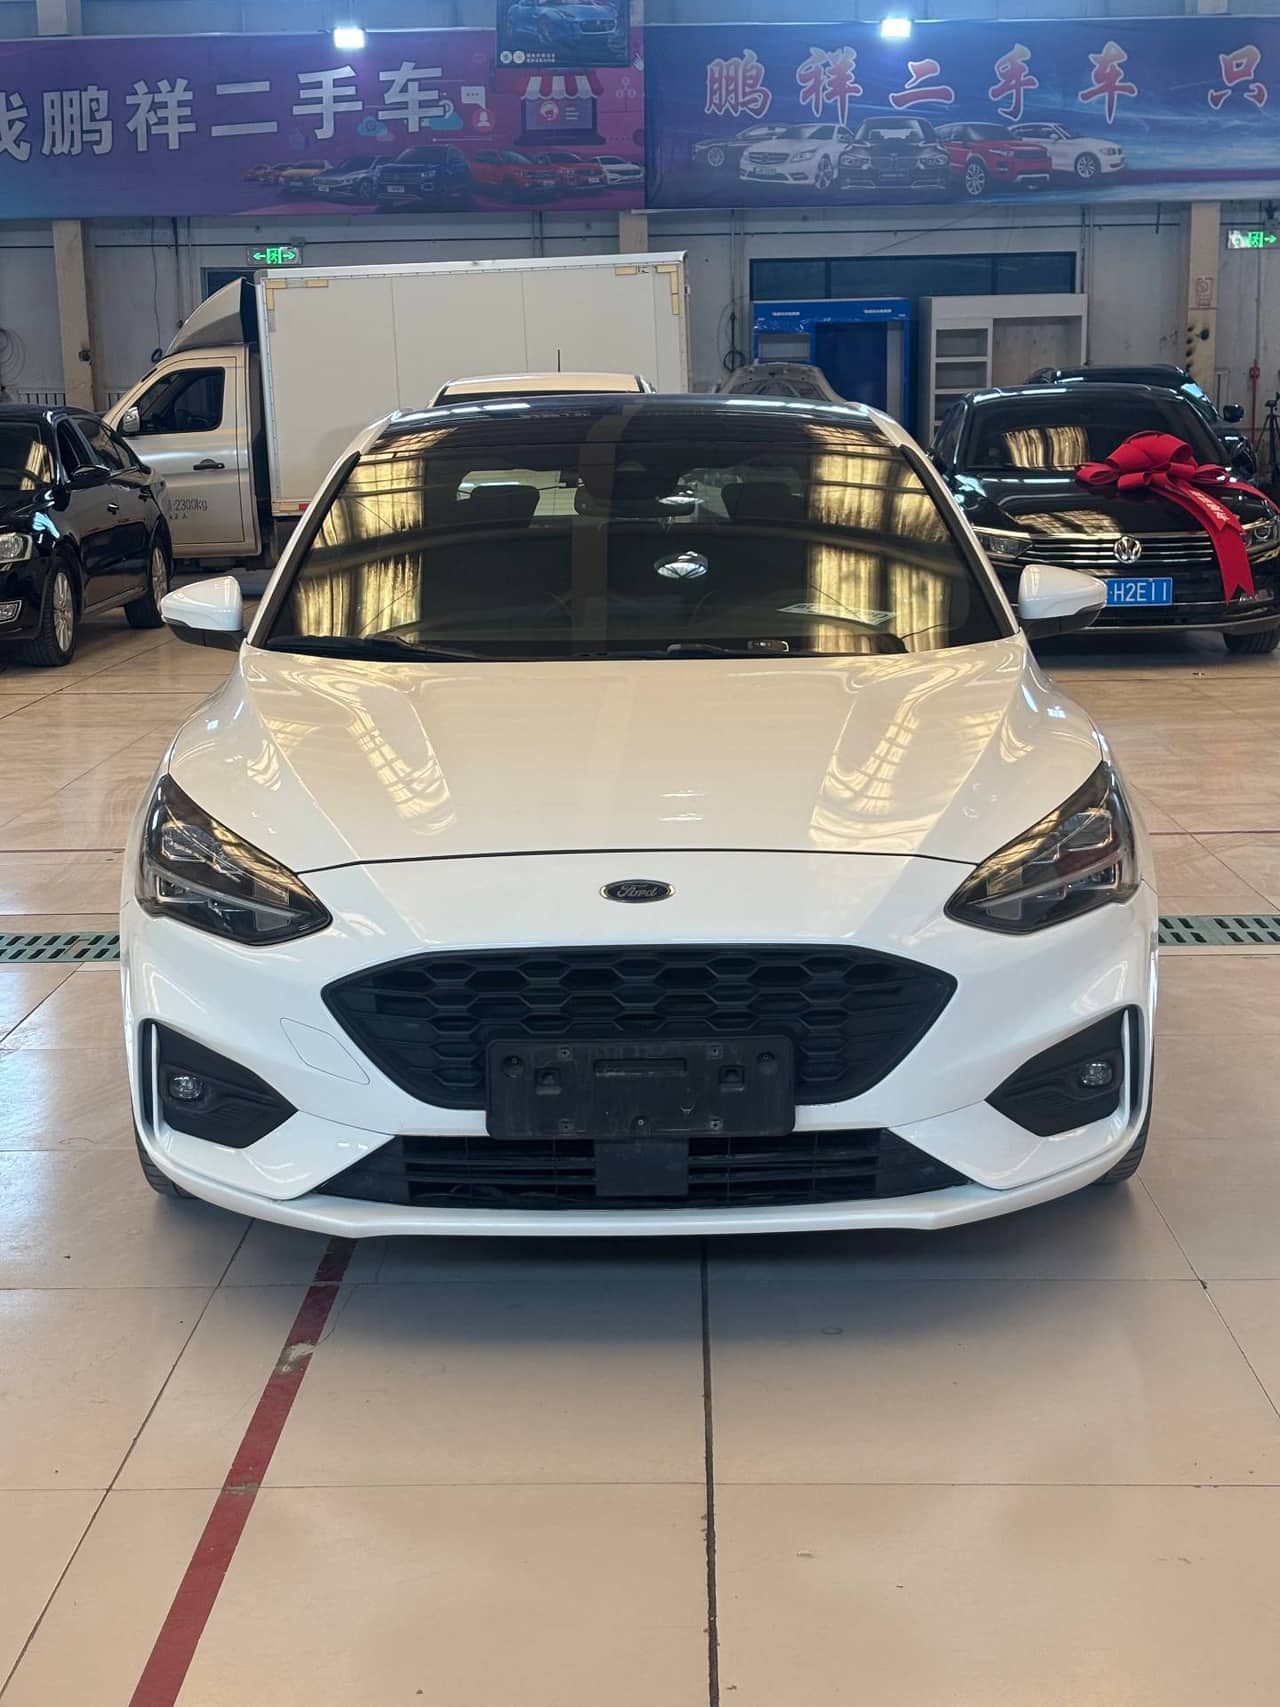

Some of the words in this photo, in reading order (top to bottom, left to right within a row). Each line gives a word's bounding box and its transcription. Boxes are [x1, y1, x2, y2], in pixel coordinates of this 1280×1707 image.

[704, 40, 1138, 126] 鹏祥二手车
[1208, 44, 1268, 109] 只
[616, 882, 658, 898] Ford
